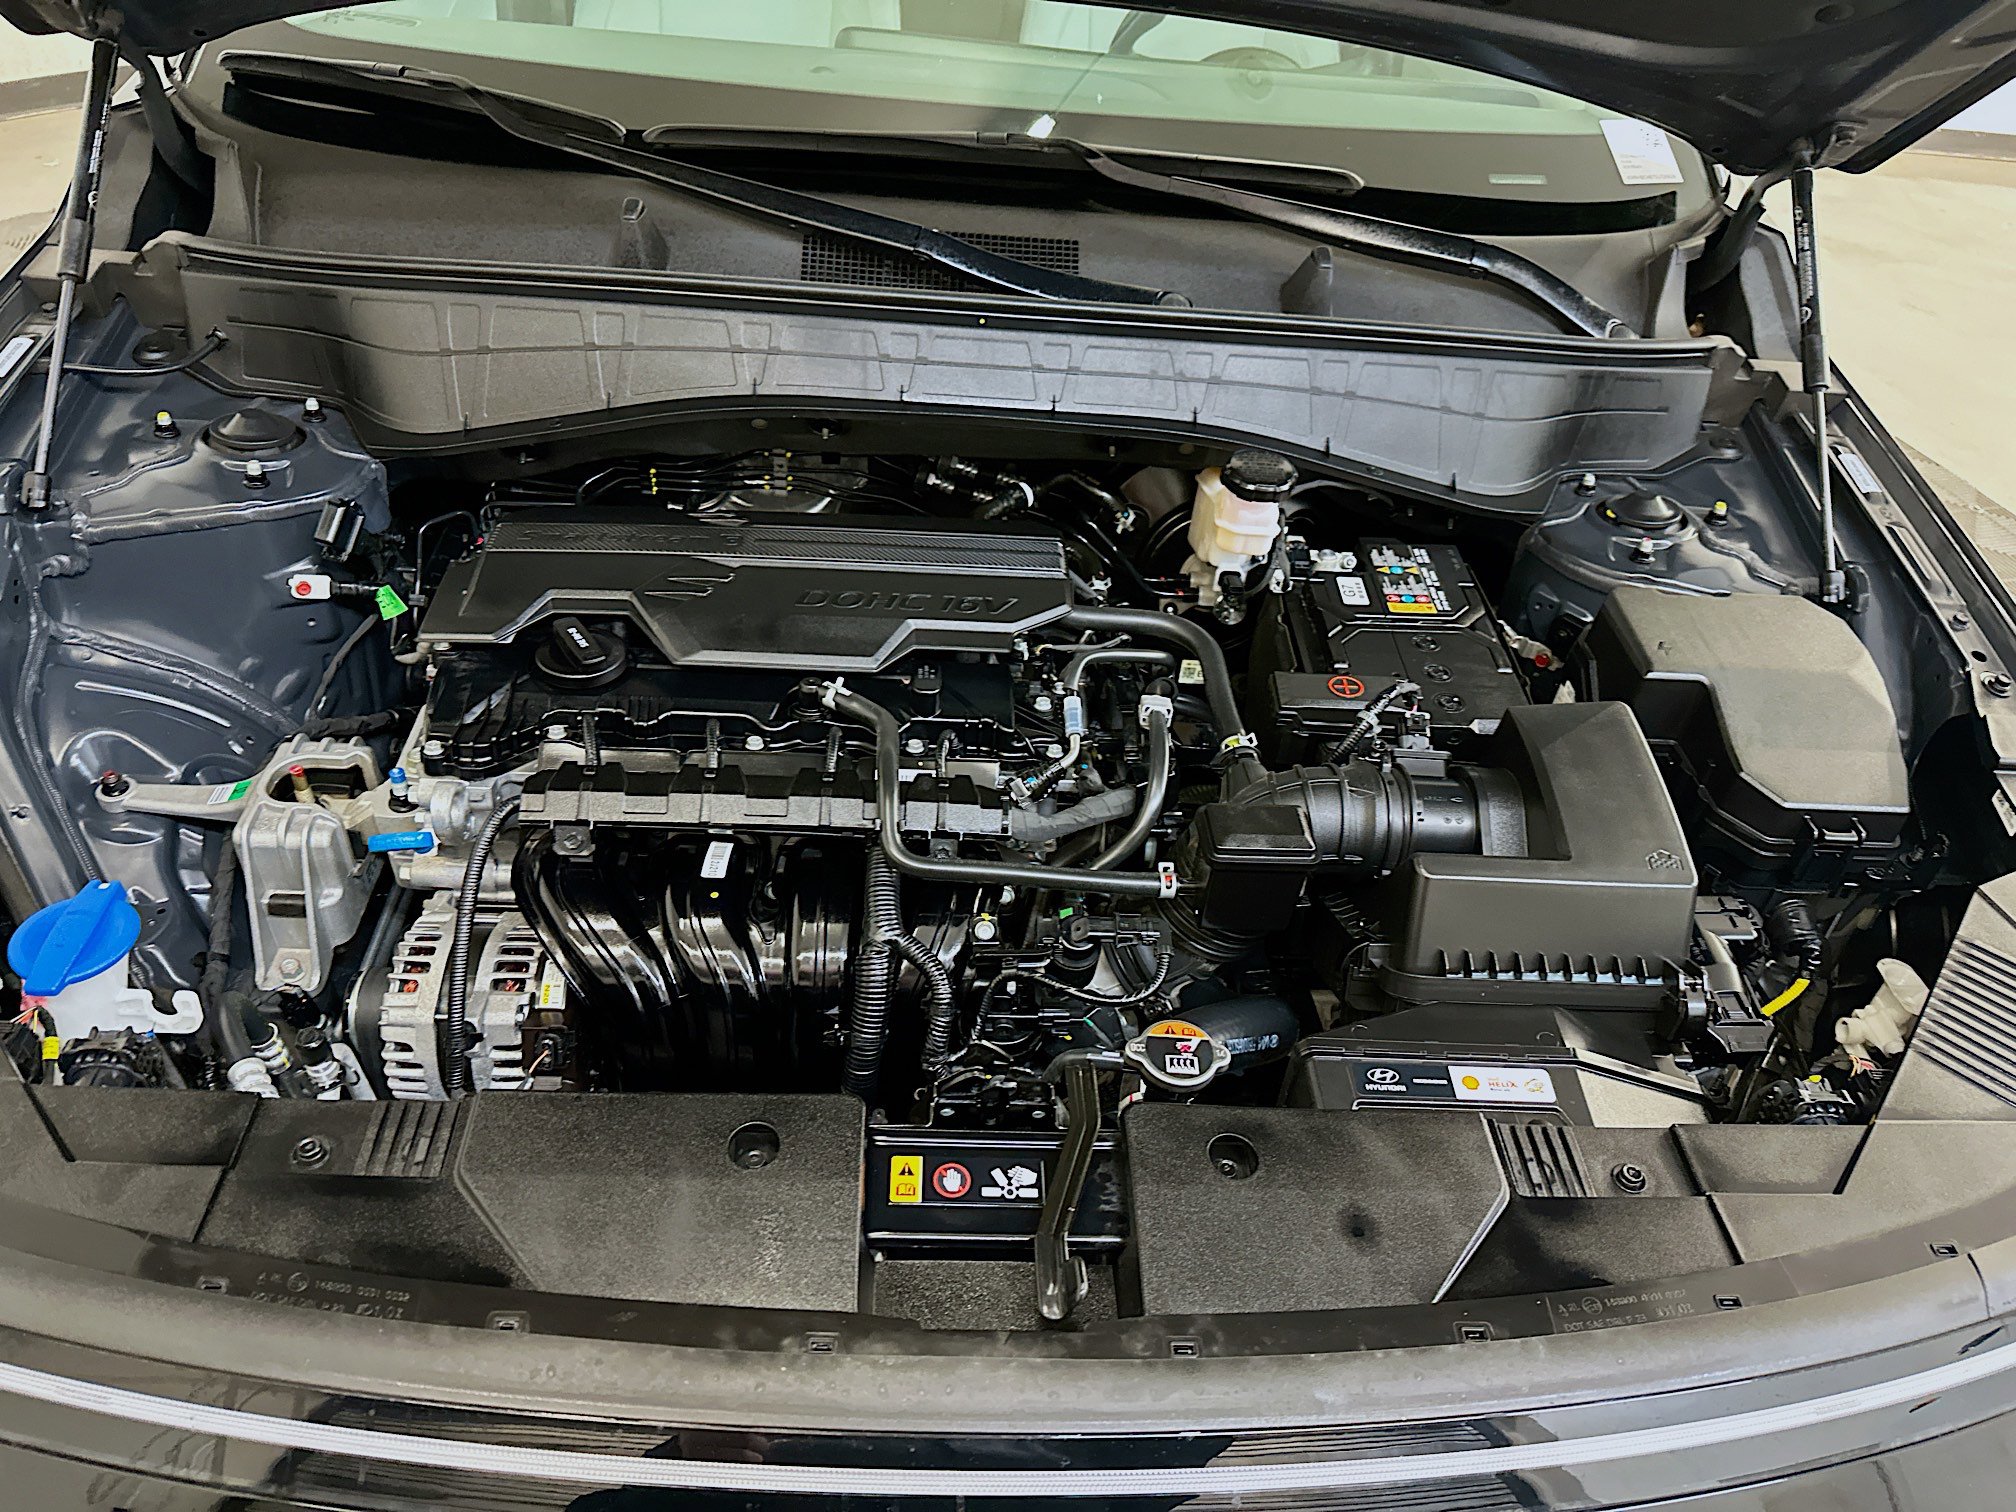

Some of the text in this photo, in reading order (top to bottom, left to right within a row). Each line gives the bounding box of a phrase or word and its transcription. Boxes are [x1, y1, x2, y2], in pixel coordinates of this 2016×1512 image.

[795, 589, 1019, 615] DOHC 16V
[1365, 1083, 1407, 1092] HYUNDAI
[1488, 1080, 1518, 1089] HELIX
